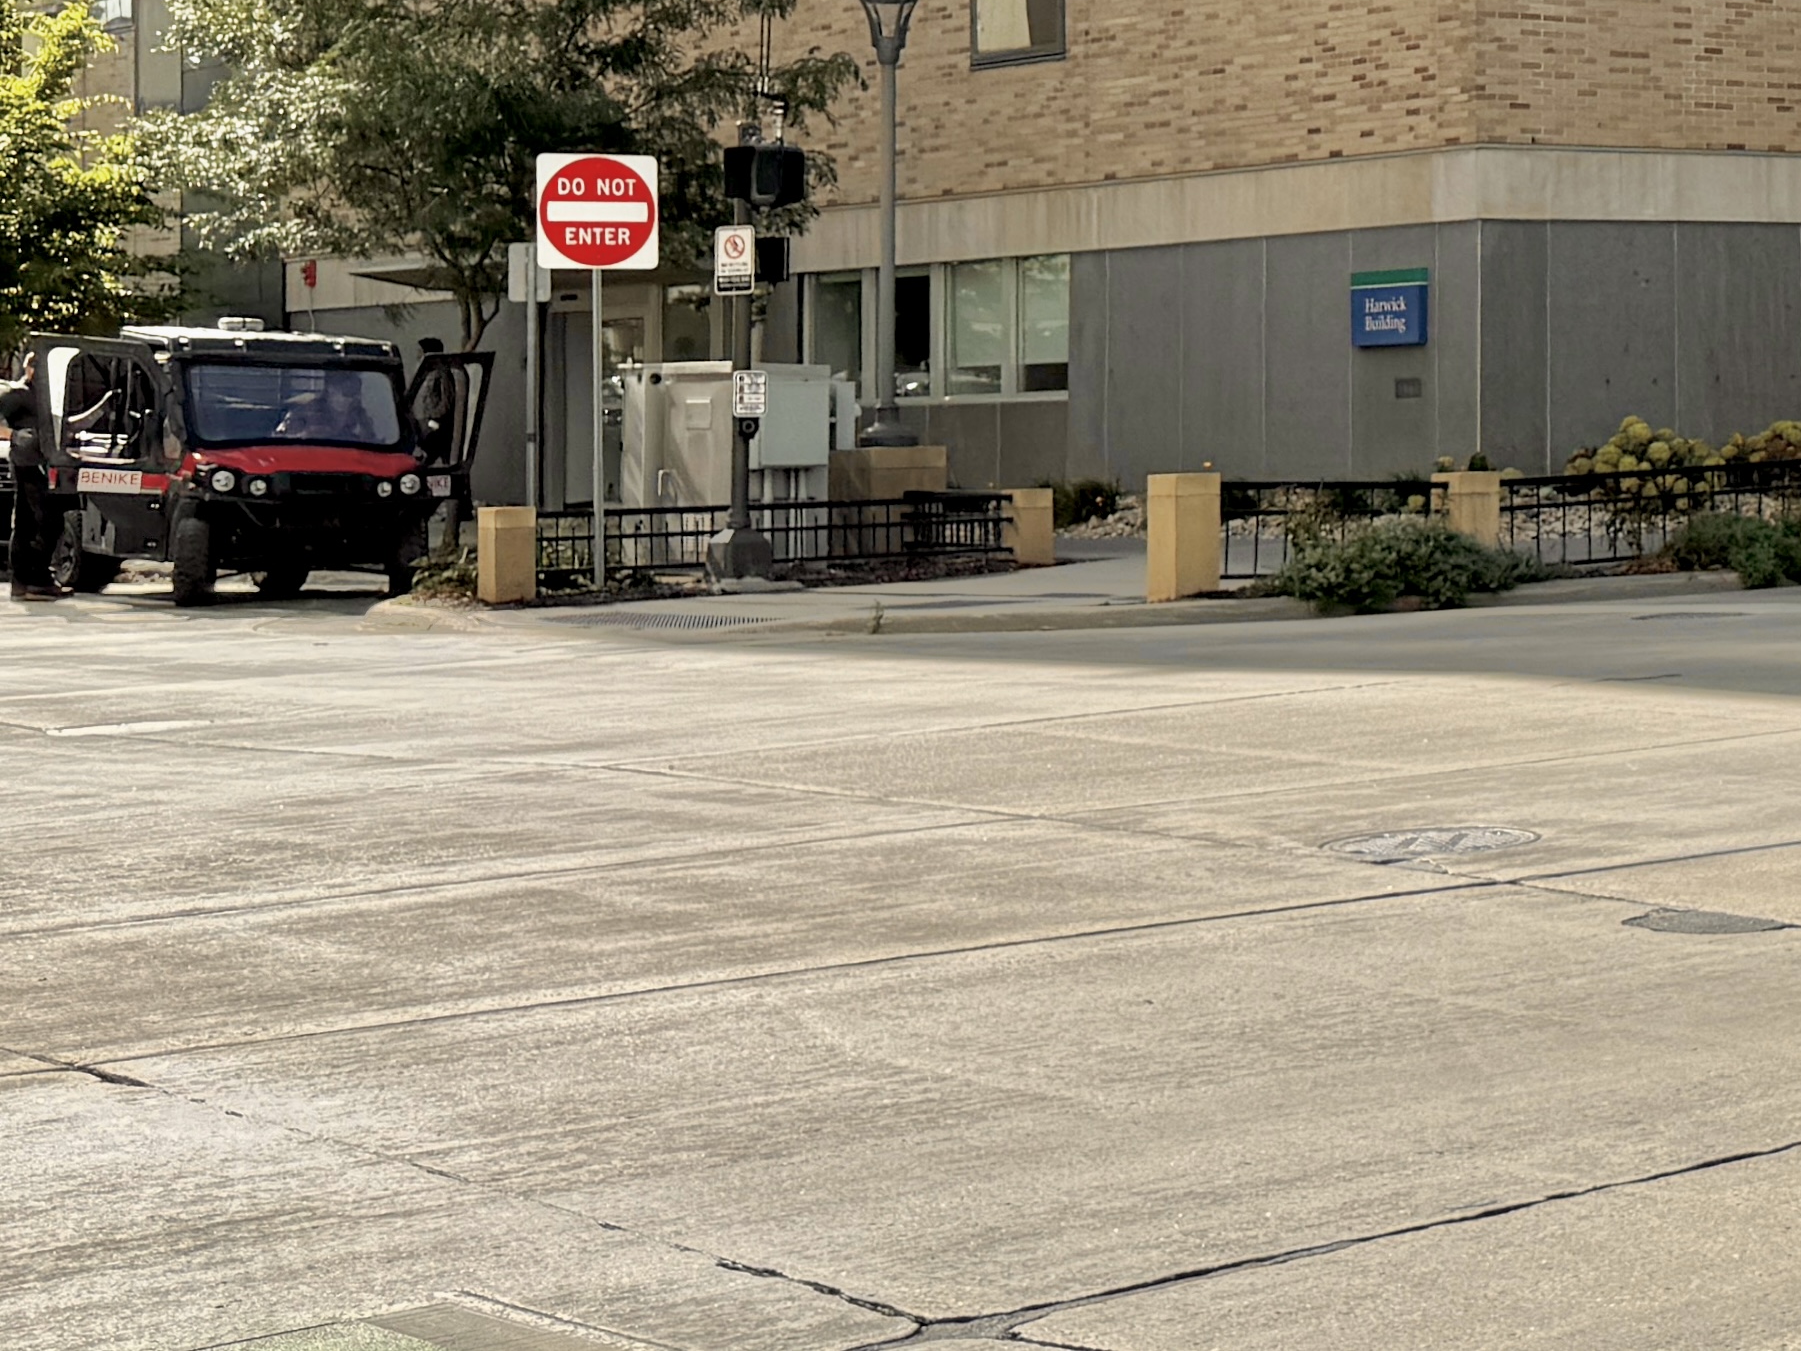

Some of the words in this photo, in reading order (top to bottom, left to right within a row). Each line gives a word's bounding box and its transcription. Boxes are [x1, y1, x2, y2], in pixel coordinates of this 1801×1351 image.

[557, 177, 585, 196] DO
[597, 178, 637, 196] NOT
[565, 226, 631, 246] ENTER
[1365, 296, 1407, 313] Harwick
[1365, 314, 1406, 334] Building
[81, 471, 139, 485] BENIKE
